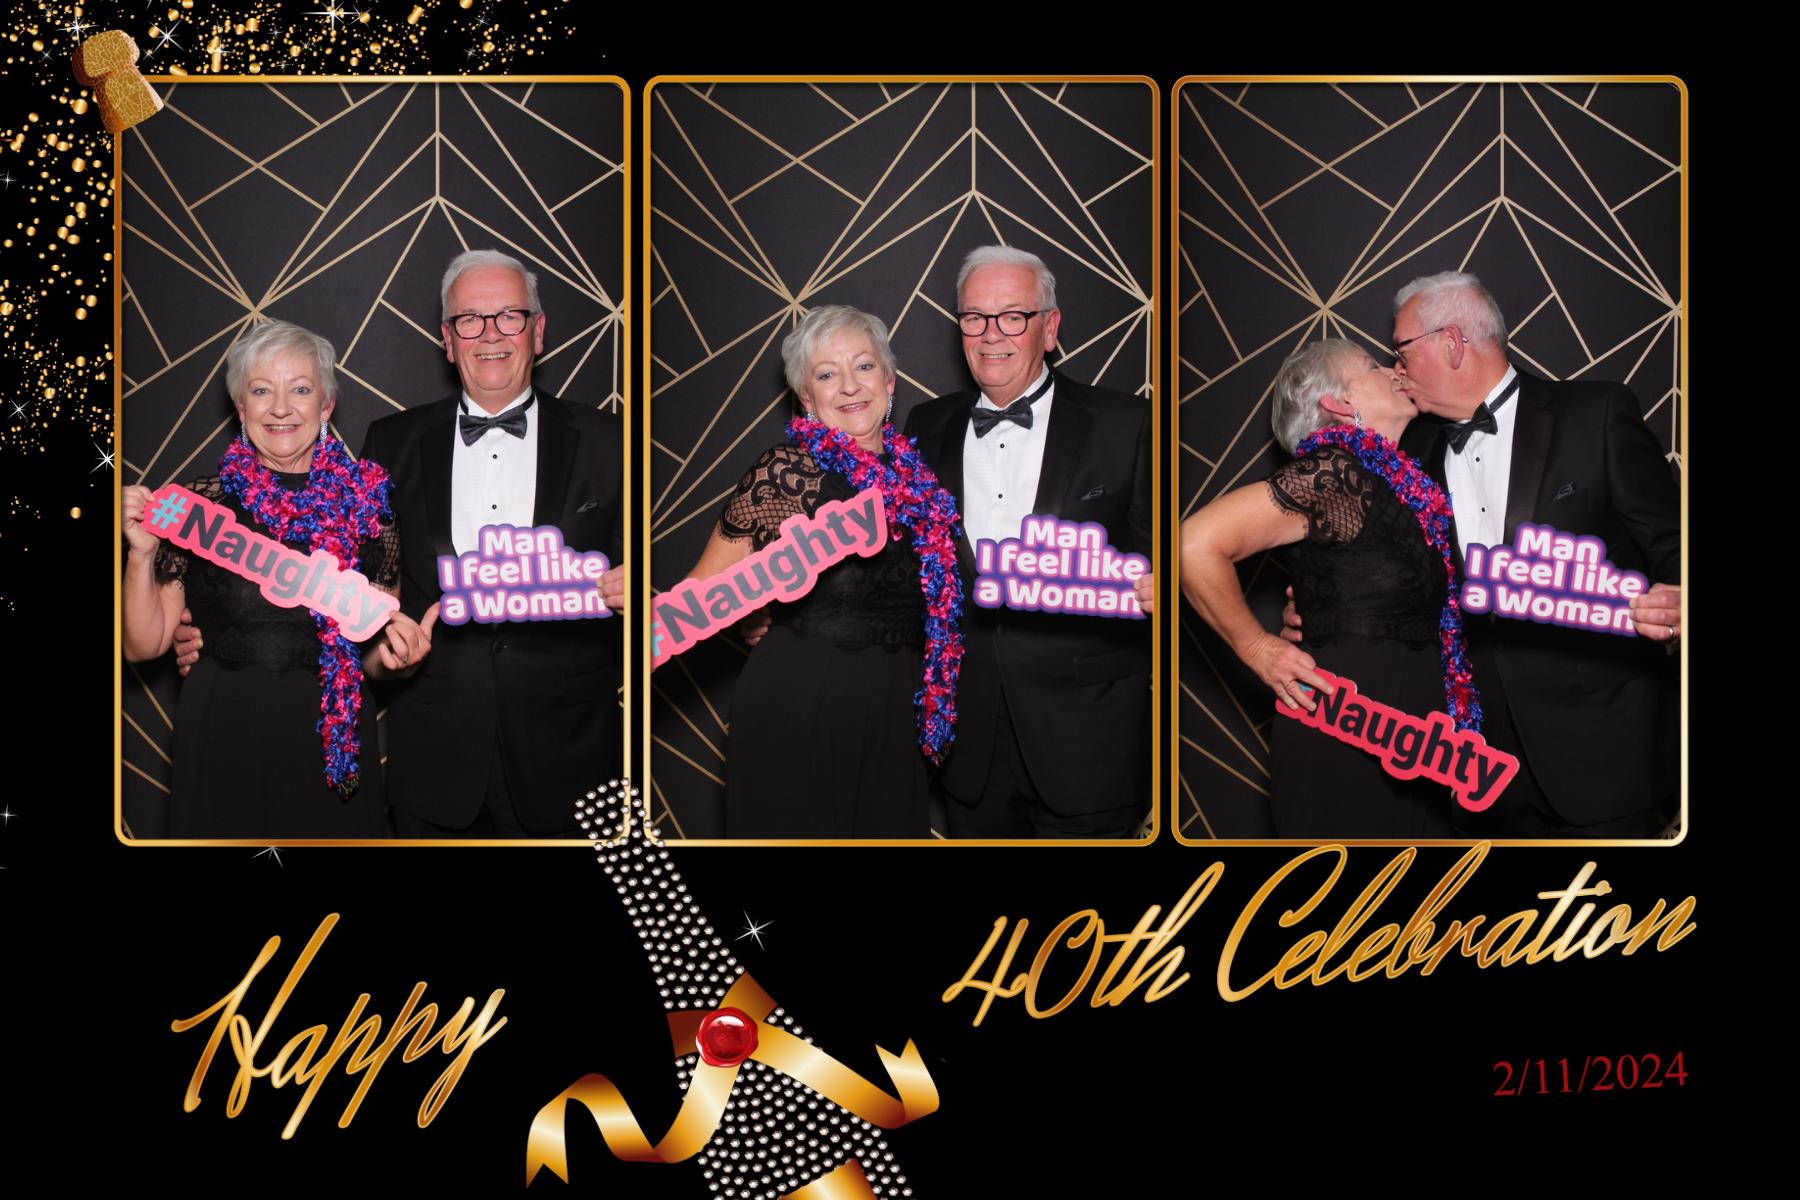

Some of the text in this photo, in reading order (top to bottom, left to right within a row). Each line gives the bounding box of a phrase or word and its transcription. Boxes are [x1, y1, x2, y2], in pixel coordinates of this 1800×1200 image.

[484, 528, 558, 557] Man
[1026, 520, 1101, 549] Man
[1519, 529, 1599, 563] Man
[150, 491, 389, 632] #Naughty
[444, 552, 604, 586] I feel like
[982, 541, 1144, 580] I feel like
[1470, 549, 1642, 598] I feel like
[446, 592, 606, 620] a Woman
[979, 578, 1140, 613] a Woman
[1466, 586, 1634, 631] a Woman
